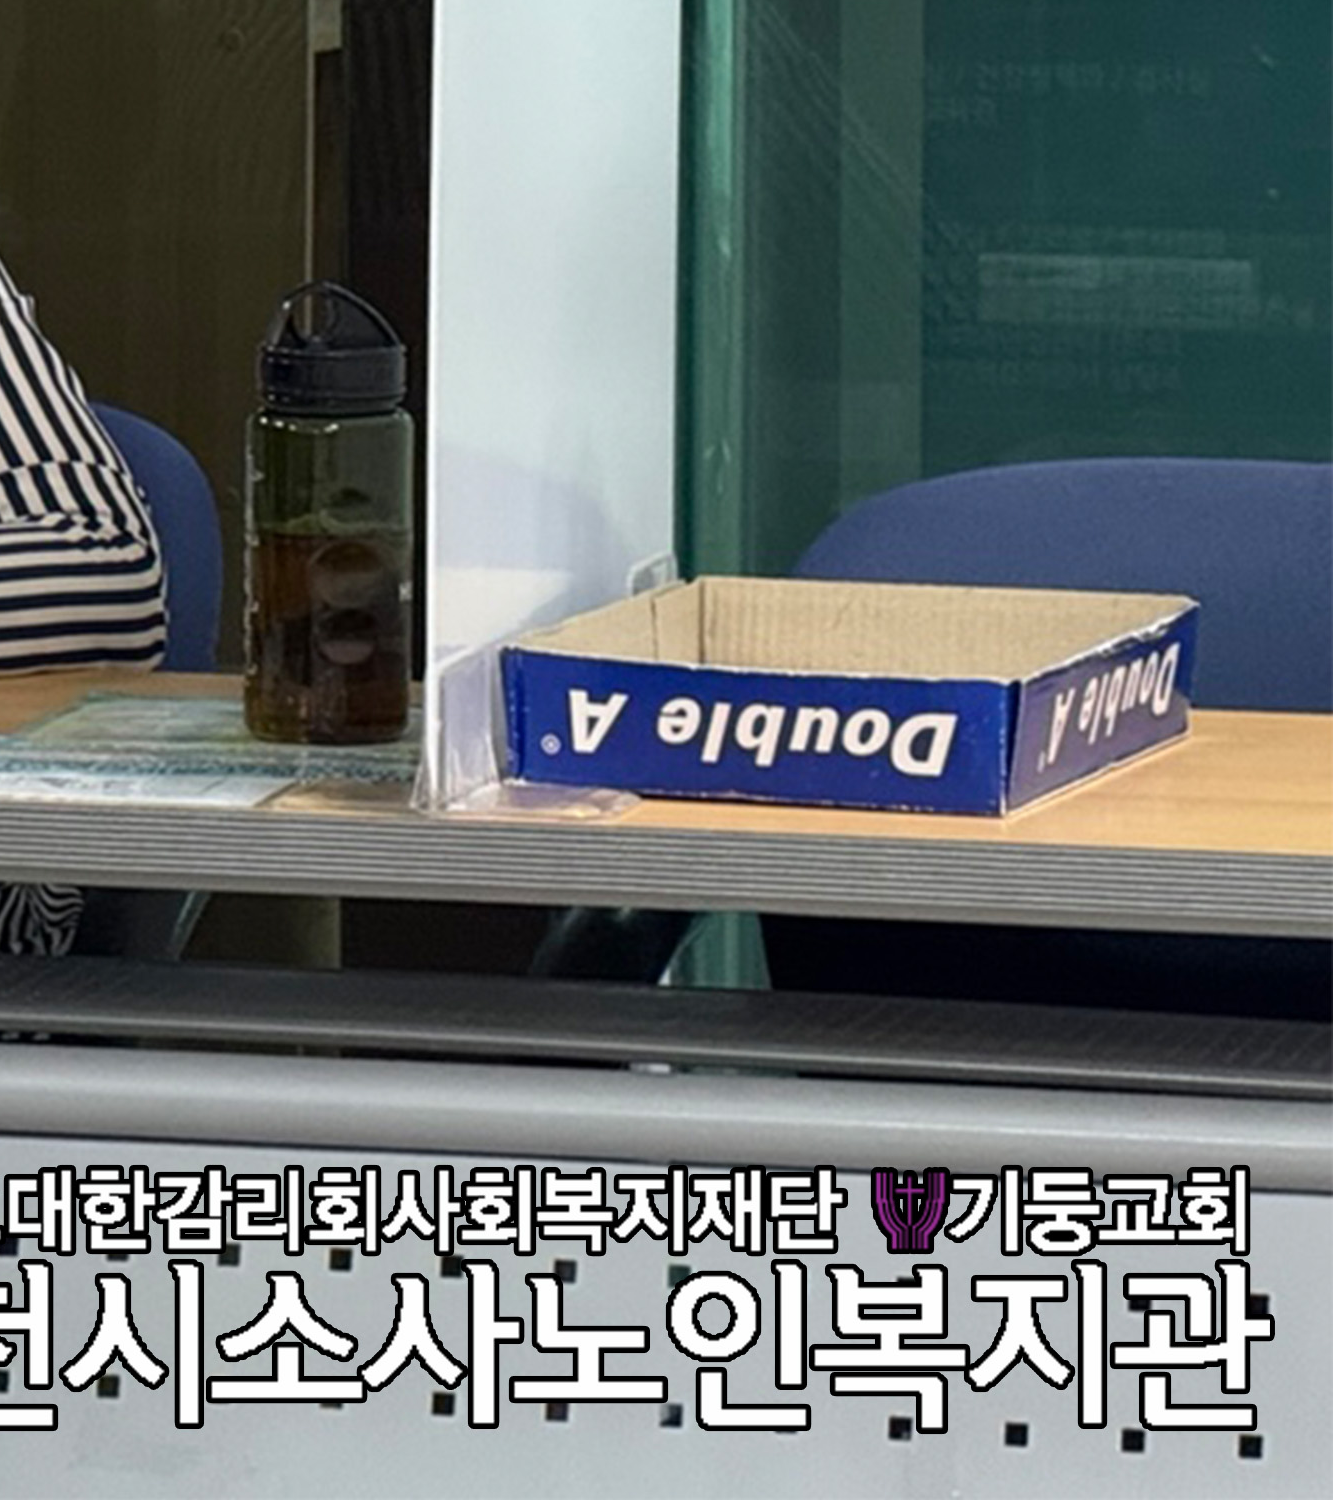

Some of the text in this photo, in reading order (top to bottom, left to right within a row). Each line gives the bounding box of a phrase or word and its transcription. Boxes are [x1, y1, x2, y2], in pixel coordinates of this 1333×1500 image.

[568, 688, 959, 777] Double A
[1045, 642, 1182, 764] Double A
